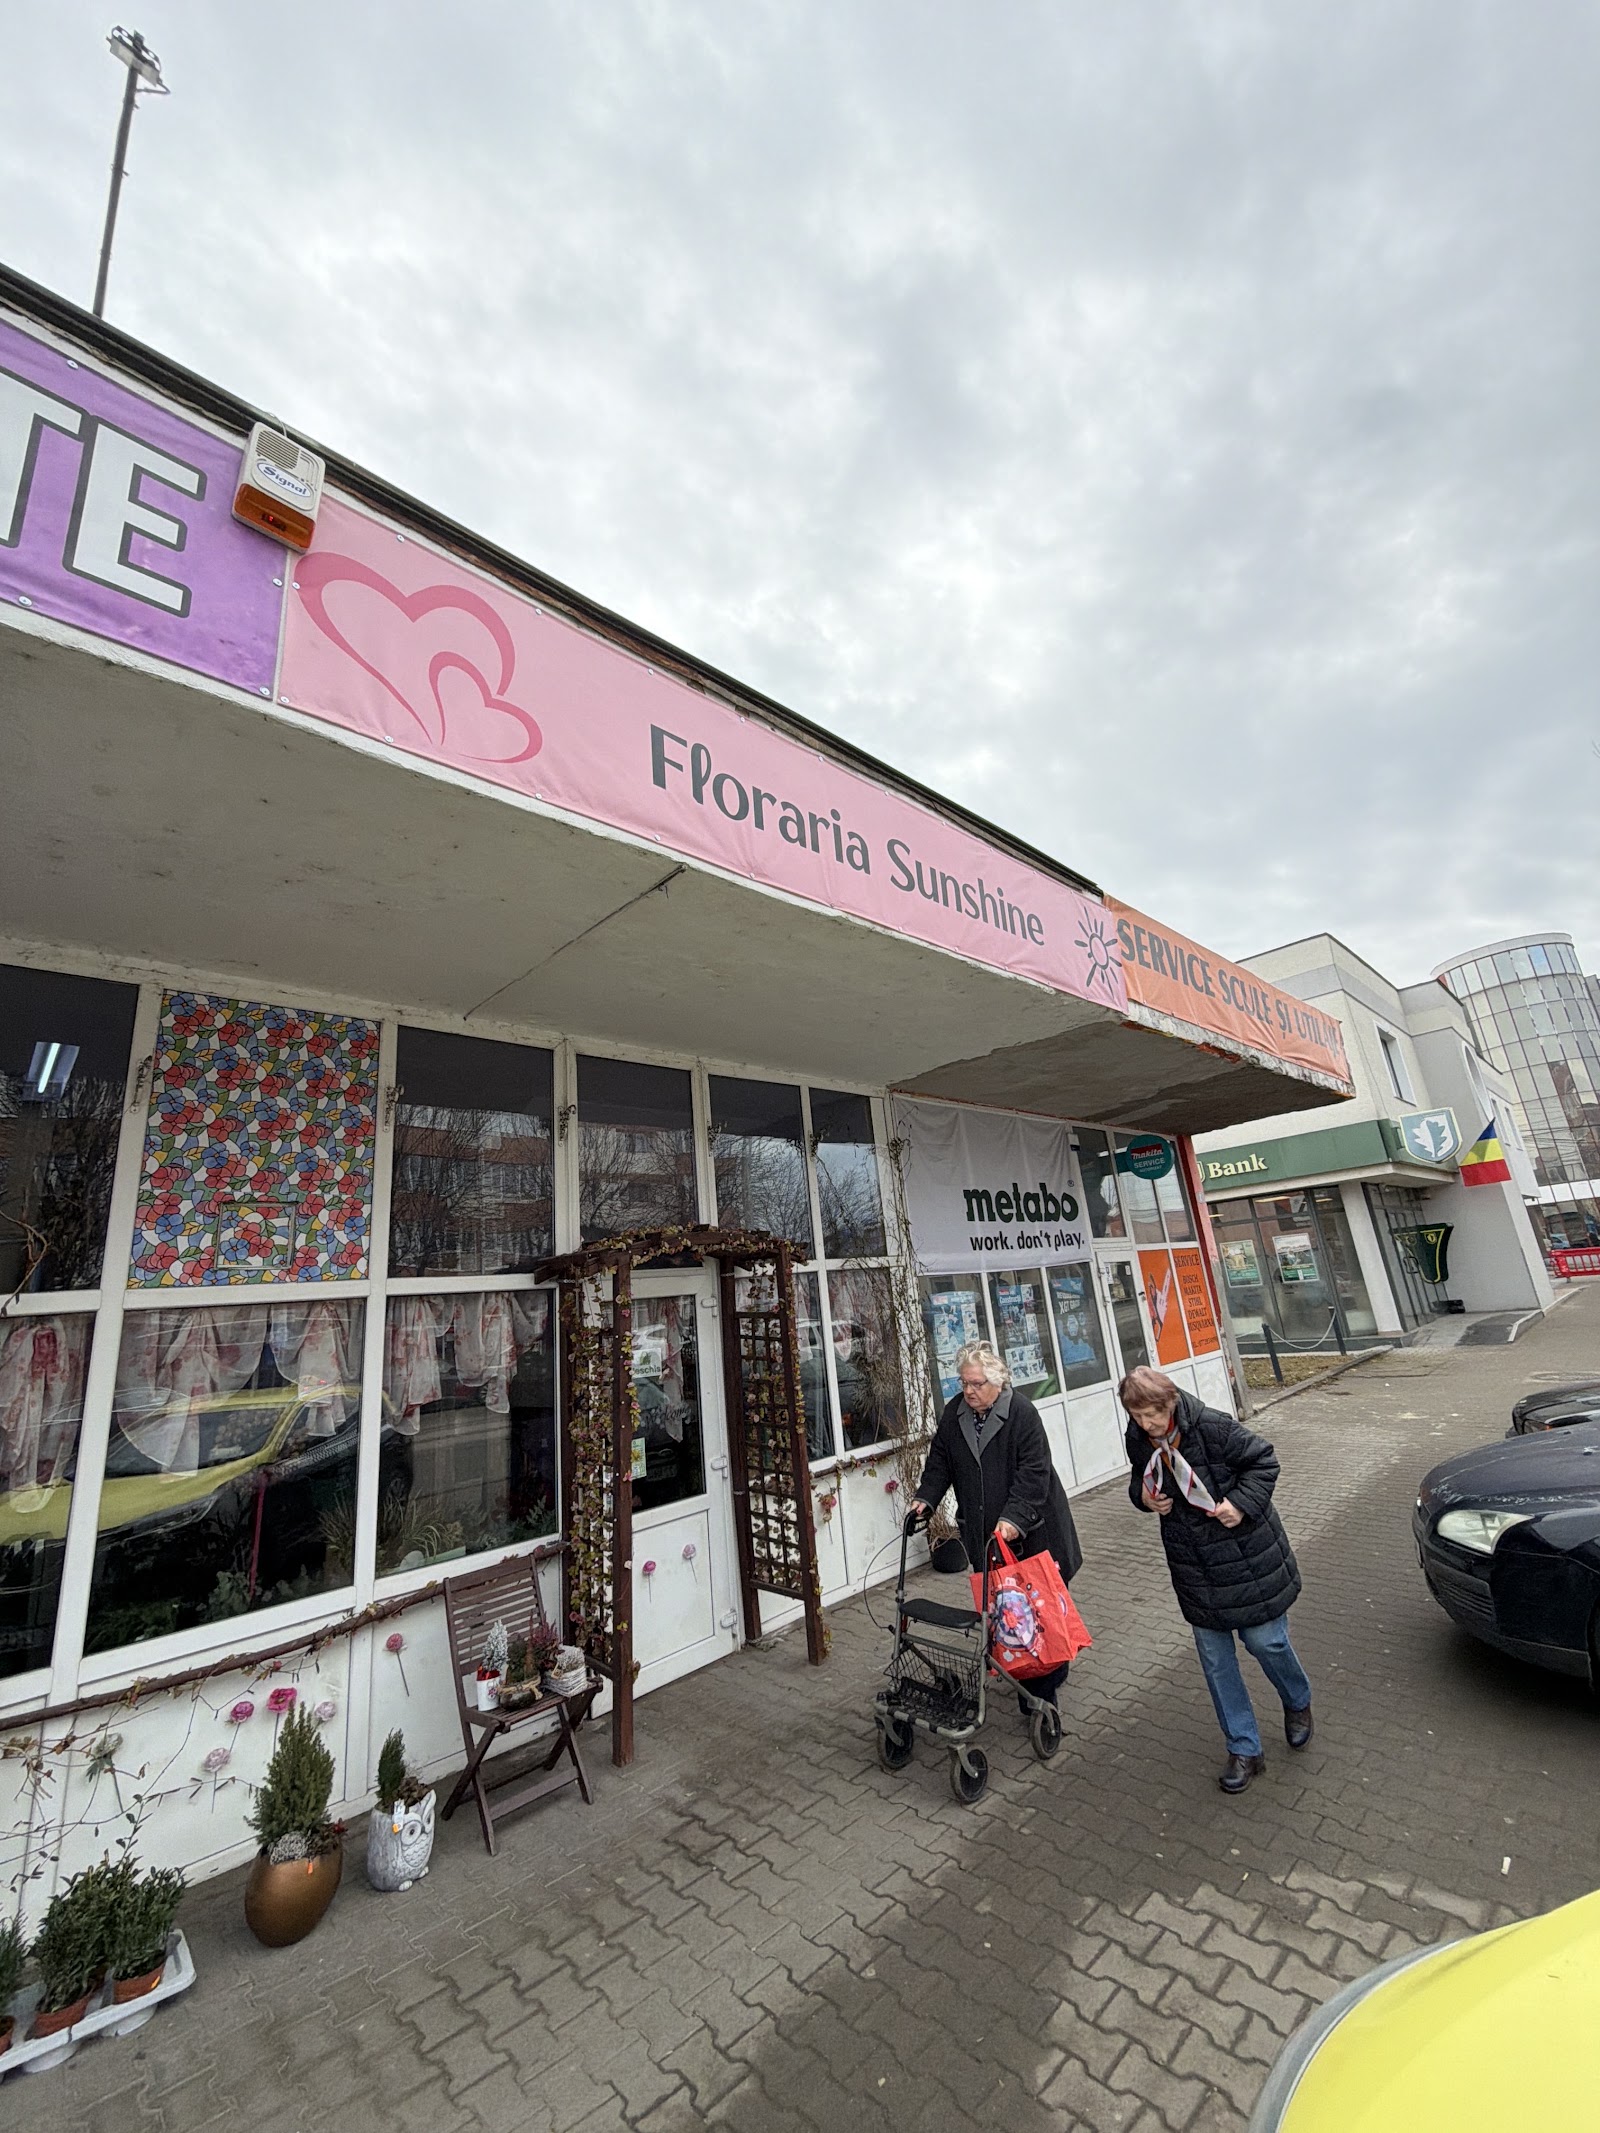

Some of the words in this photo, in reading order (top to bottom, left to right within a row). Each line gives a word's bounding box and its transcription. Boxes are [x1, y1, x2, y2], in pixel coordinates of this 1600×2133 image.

[263, 465, 307, 495] Signal
[650, 723, 871, 875] Floraria
[886, 838, 1045, 946] Sunshine
[1117, 918, 1215, 998] SERVICE
[1218, 969, 1273, 1026] SCULE
[1131, 1149, 1164, 1160] makita
[1134, 1157, 1165, 1169] SERVICE
[1206, 1153, 1268, 1179] Bank
[963, 1182, 1079, 1223] metabo
[970, 1230, 1014, 1251] work.
[1017, 1230, 1051, 1250] don't
[1055, 1229, 1085, 1251] play.
[1174, 1254, 1200, 1268] SERVICE
